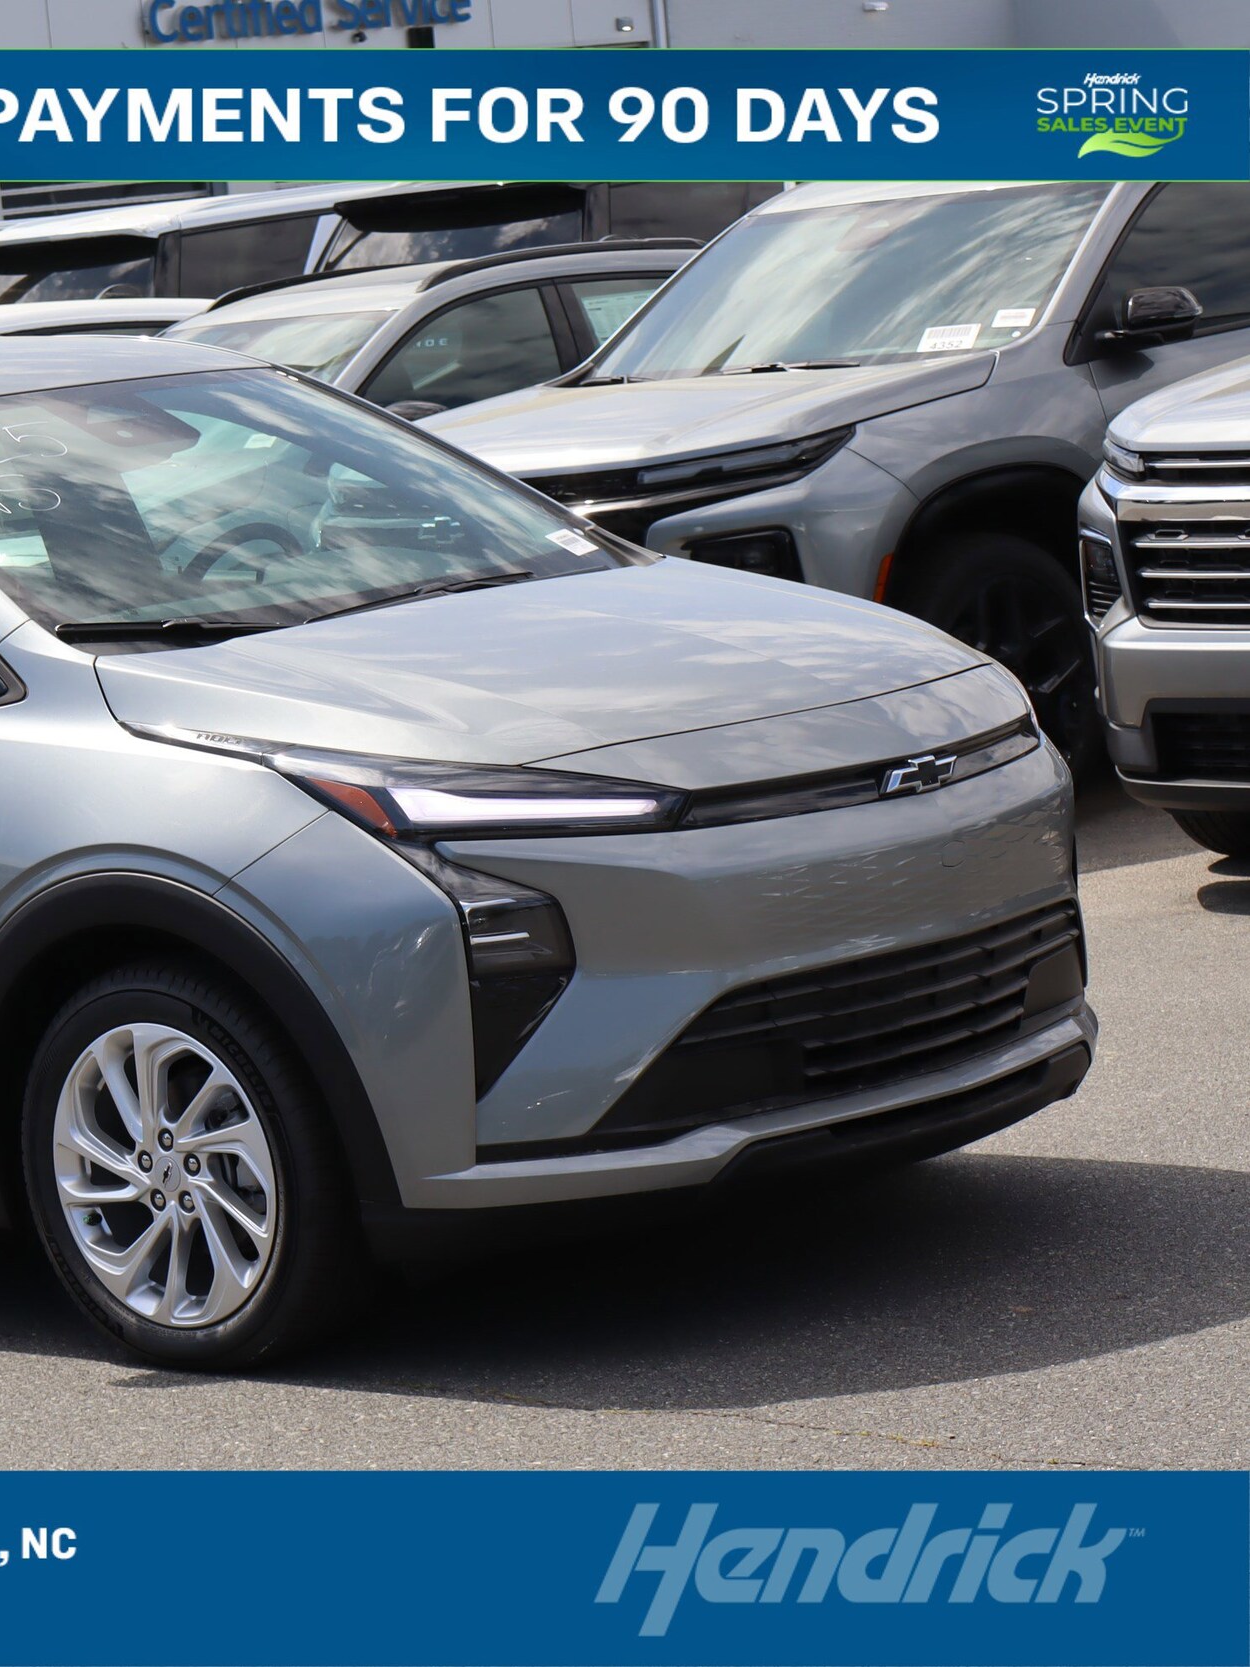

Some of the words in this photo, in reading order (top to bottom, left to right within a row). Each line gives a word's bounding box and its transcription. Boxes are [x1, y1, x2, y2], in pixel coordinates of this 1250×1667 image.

[149, 0, 323, 43] Certified
[337, 0, 473, 30] Service
[930, 340, 963, 350] 4352
